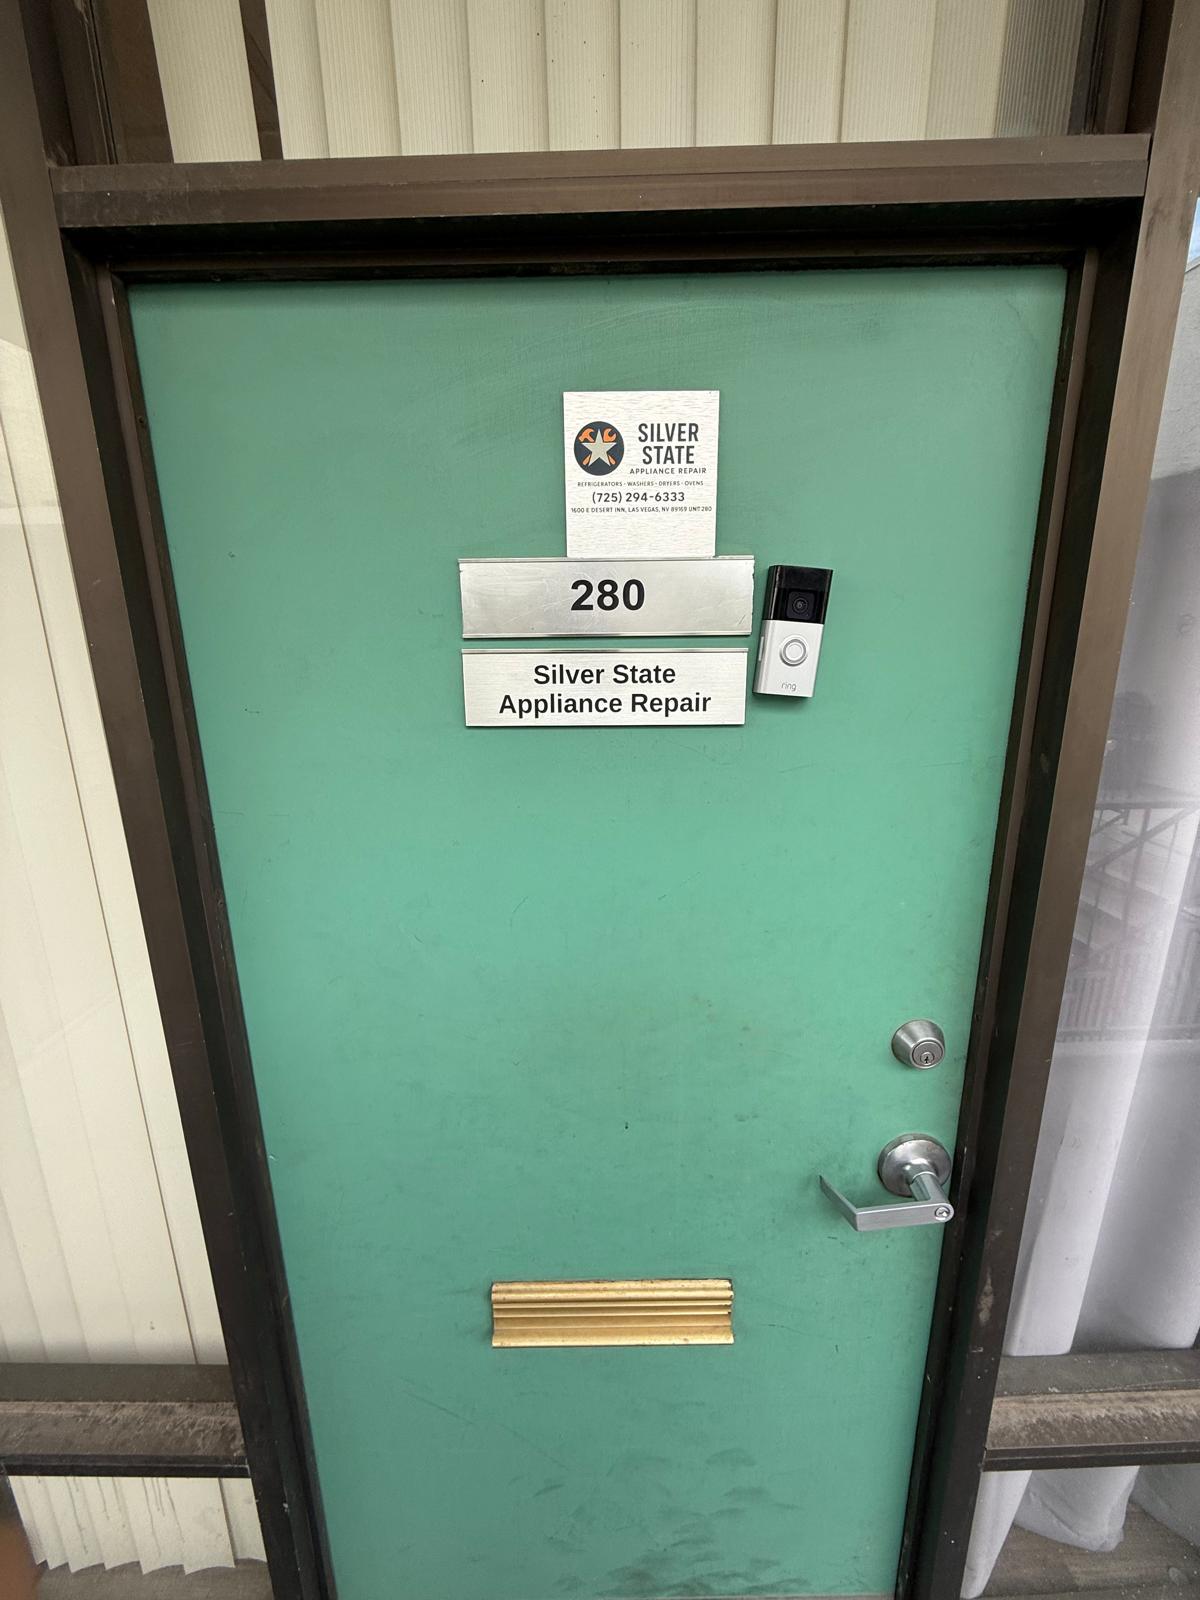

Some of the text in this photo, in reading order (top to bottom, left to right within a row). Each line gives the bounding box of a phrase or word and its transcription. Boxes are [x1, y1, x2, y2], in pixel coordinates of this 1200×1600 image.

[638, 423, 699, 442] SILVER
[642, 445, 695, 465] STATE
[629, 467, 675, 475] APPLIANCE
[592, 491, 685, 504] (725) 294-6333
[570, 579, 645, 612] 280
[533, 663, 676, 685] Silver State
[781, 682, 797, 692] ring
[499, 692, 712, 719] Appliance Repair
